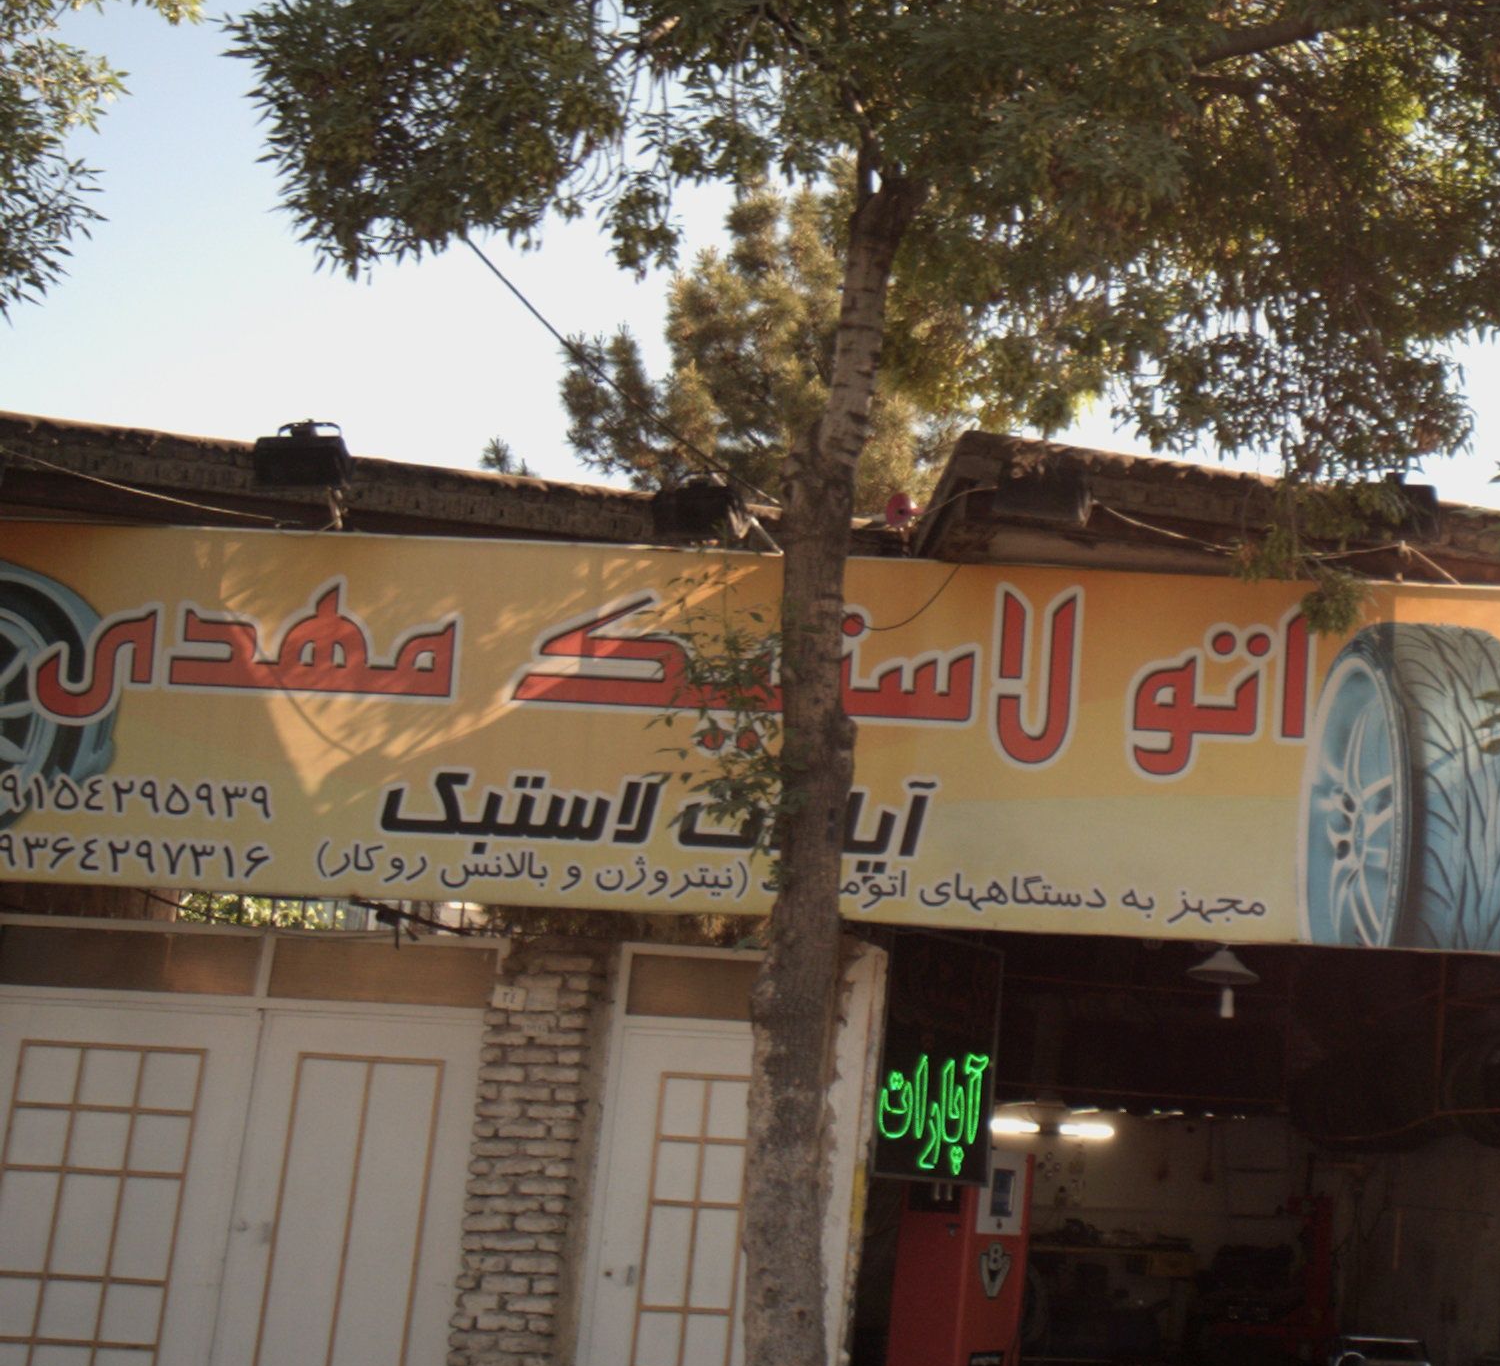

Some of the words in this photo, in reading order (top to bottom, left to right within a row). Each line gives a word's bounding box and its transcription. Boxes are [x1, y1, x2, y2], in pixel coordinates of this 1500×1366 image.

[37, 585, 456, 717] مهدی
[1134, 611, 1310, 775] اتو
[440, 851, 549, 889] بالانس
[560, 863, 582, 891] و
[919, 872, 1107, 912] دستگاههای
[1121, 886, 1157, 920] به
[1167, 889, 1268, 925] مجهز
[878, 1053, 990, 1177] آپارات
